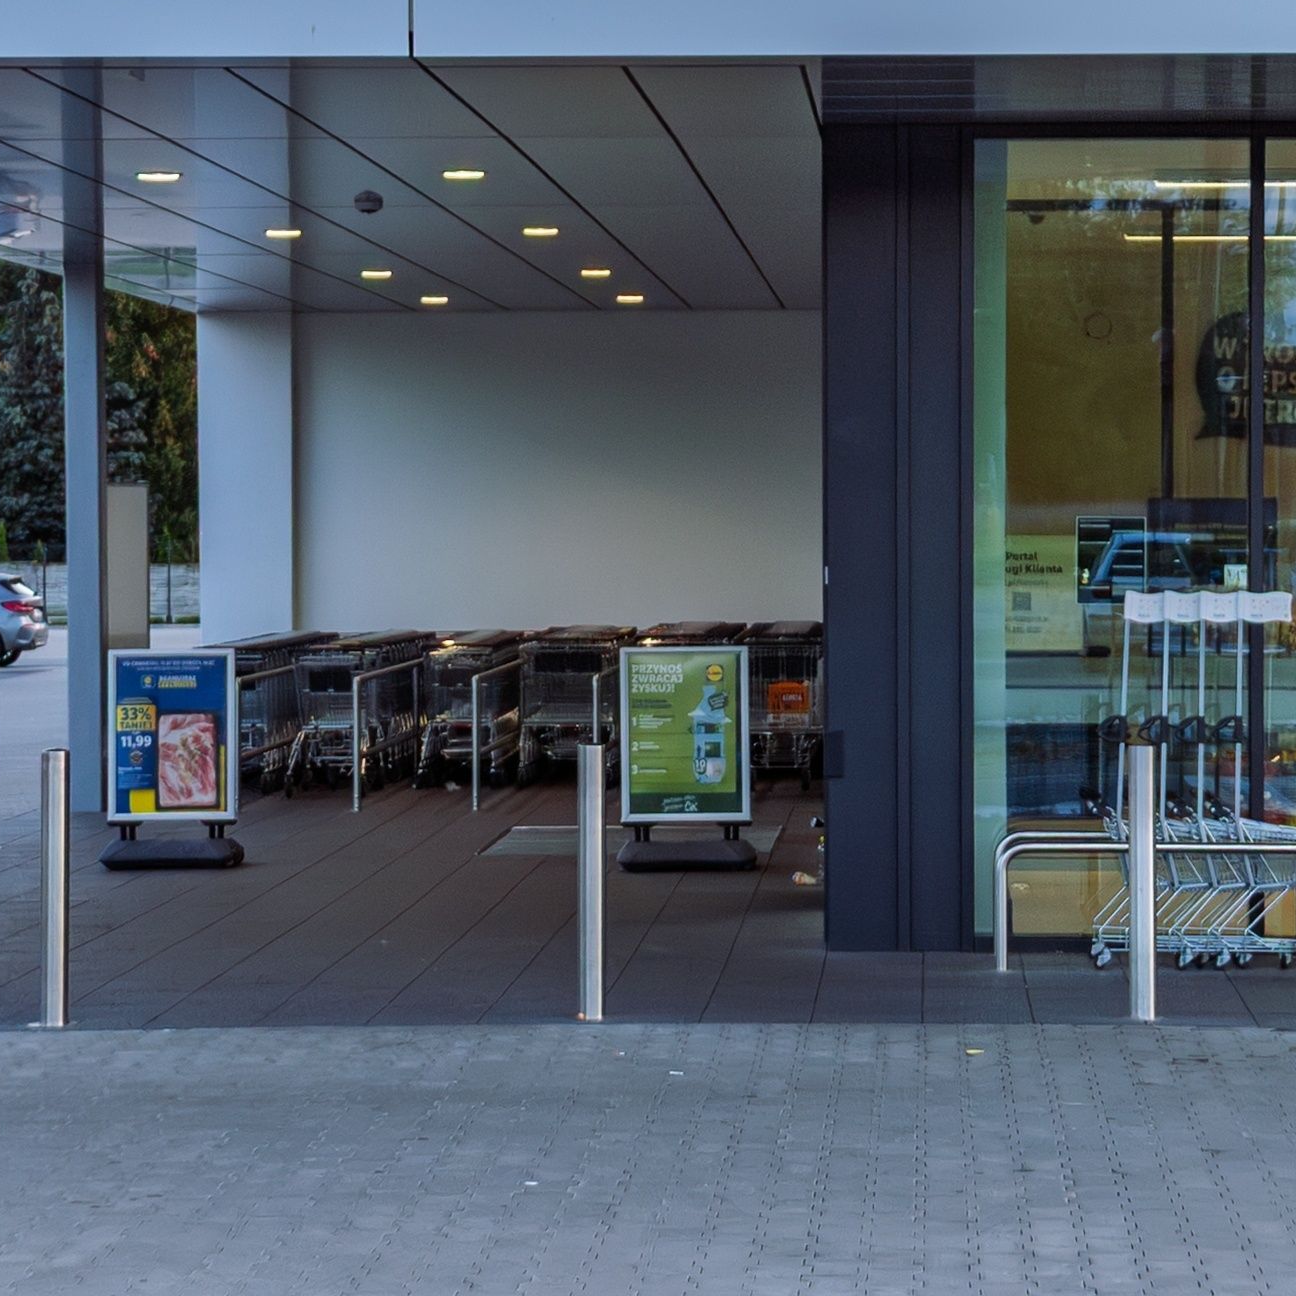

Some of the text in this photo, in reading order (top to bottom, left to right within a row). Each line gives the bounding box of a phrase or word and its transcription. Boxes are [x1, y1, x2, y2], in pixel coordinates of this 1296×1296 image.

[1214, 336, 1237, 360] W
[631, 673, 683, 683] ZWRACAJ
[631, 684, 676, 693] ZYSKUJ!
[120, 707, 152, 721] 33%
[120, 735, 153, 748] 11,99
[631, 741, 639, 752] 2
[631, 764, 639, 775] 3
